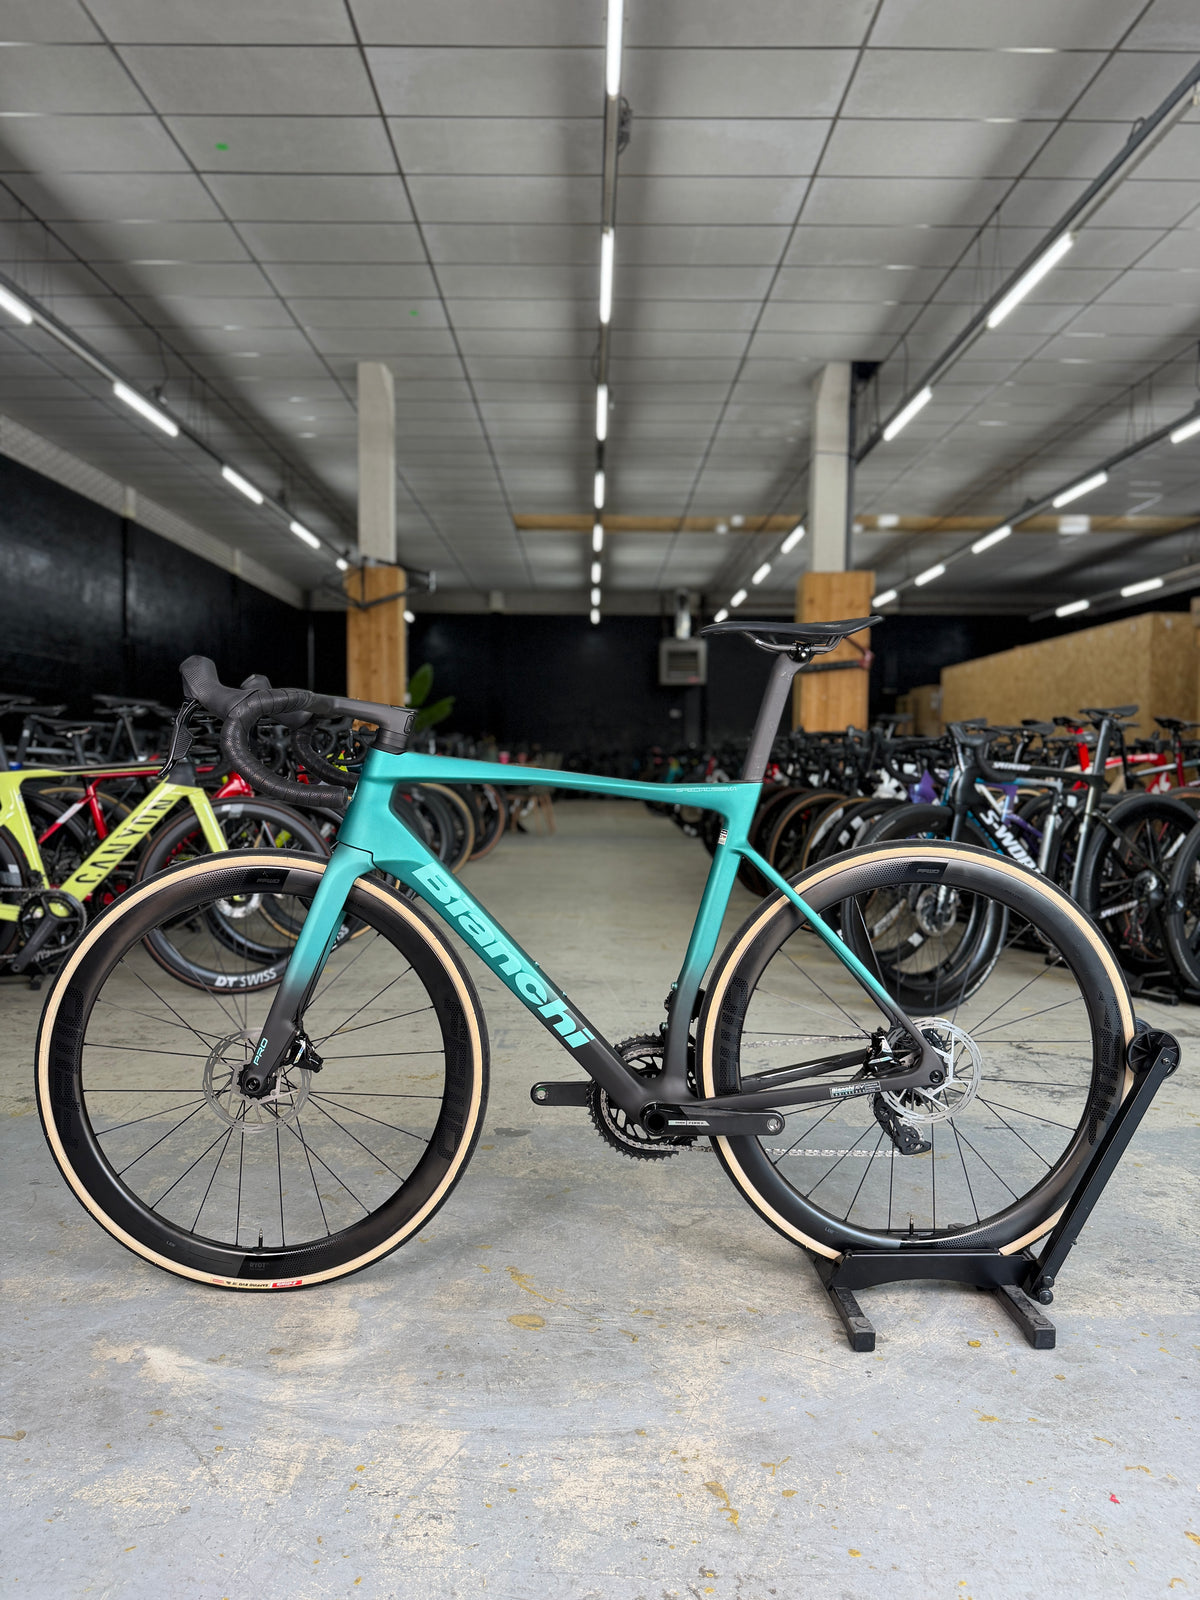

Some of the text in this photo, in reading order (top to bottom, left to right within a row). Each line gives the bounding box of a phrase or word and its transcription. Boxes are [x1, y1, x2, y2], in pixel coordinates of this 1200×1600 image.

[74, 799, 175, 884] CANYON
[214, 967, 278, 988] DT SWISS
[412, 863, 596, 1049] Bianchi
[253, 1037, 268, 1066] PRO
